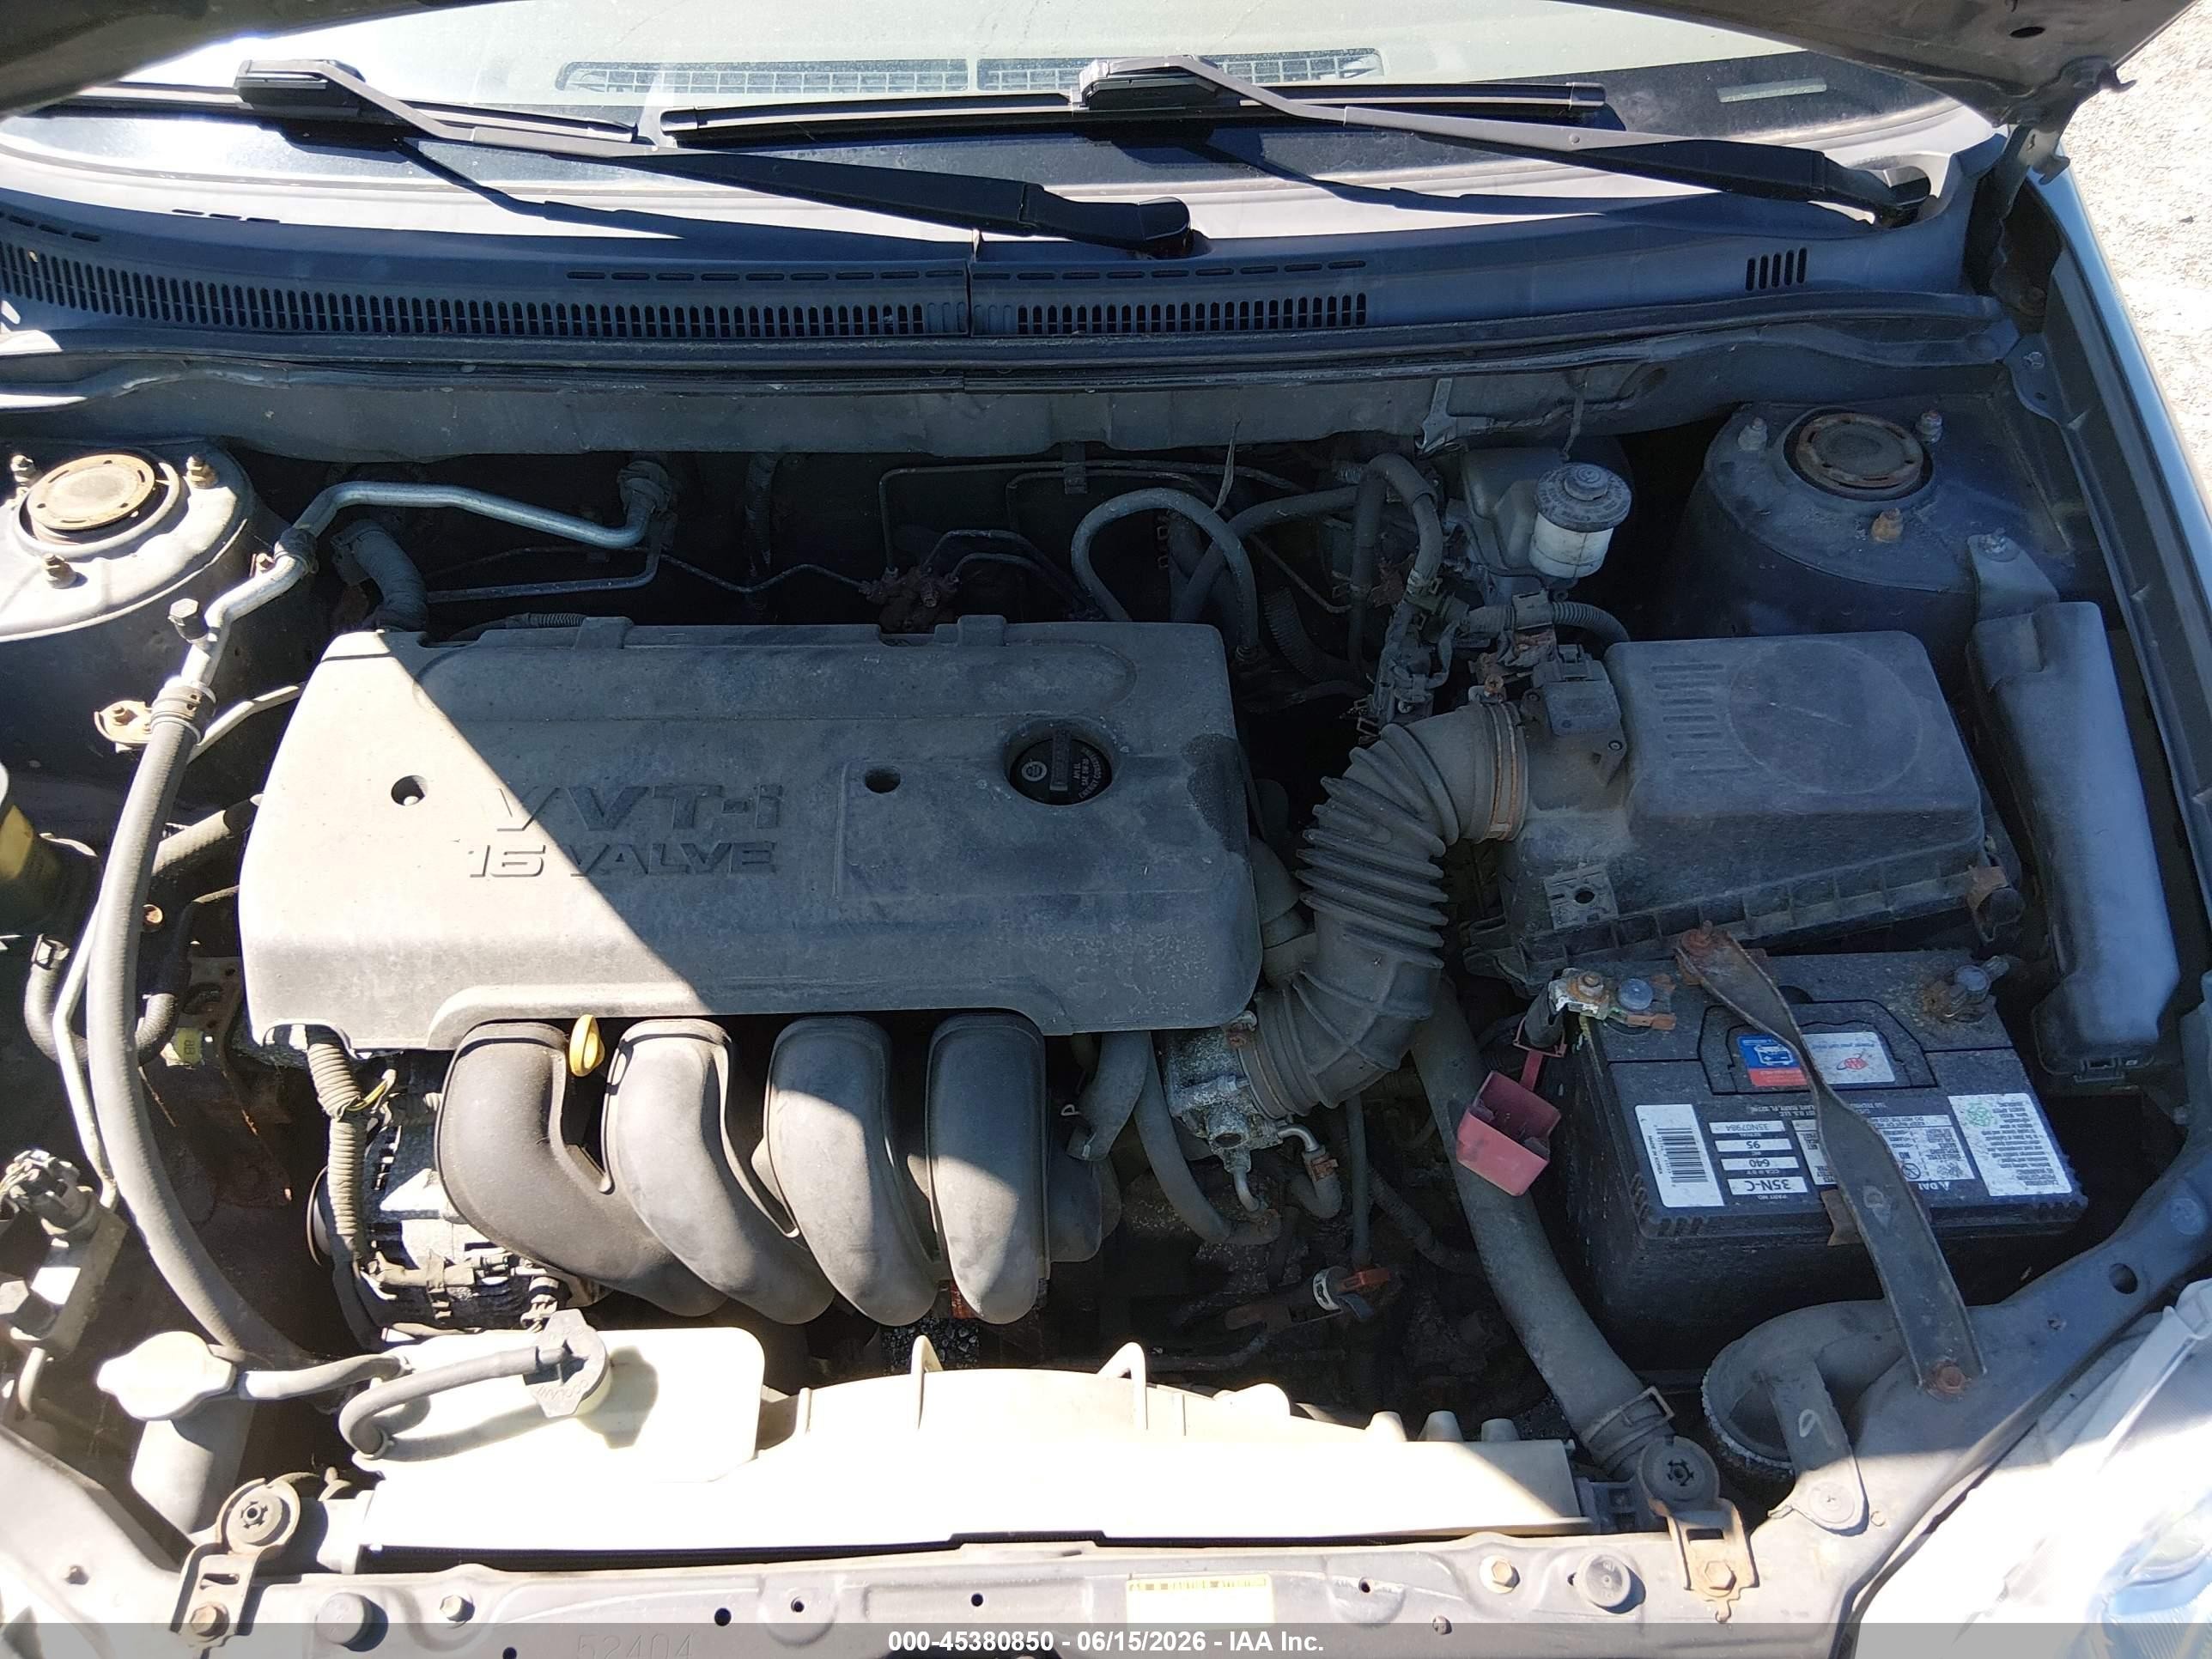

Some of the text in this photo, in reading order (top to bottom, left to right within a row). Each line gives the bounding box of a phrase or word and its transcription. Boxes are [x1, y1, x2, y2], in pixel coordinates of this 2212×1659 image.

[467, 842, 776, 878] 16 VALVE
[1746, 1140, 1761, 1149] 95
[1748, 1158, 1771, 1168] 640
[1744, 1179, 1791, 1192] 35N-C
